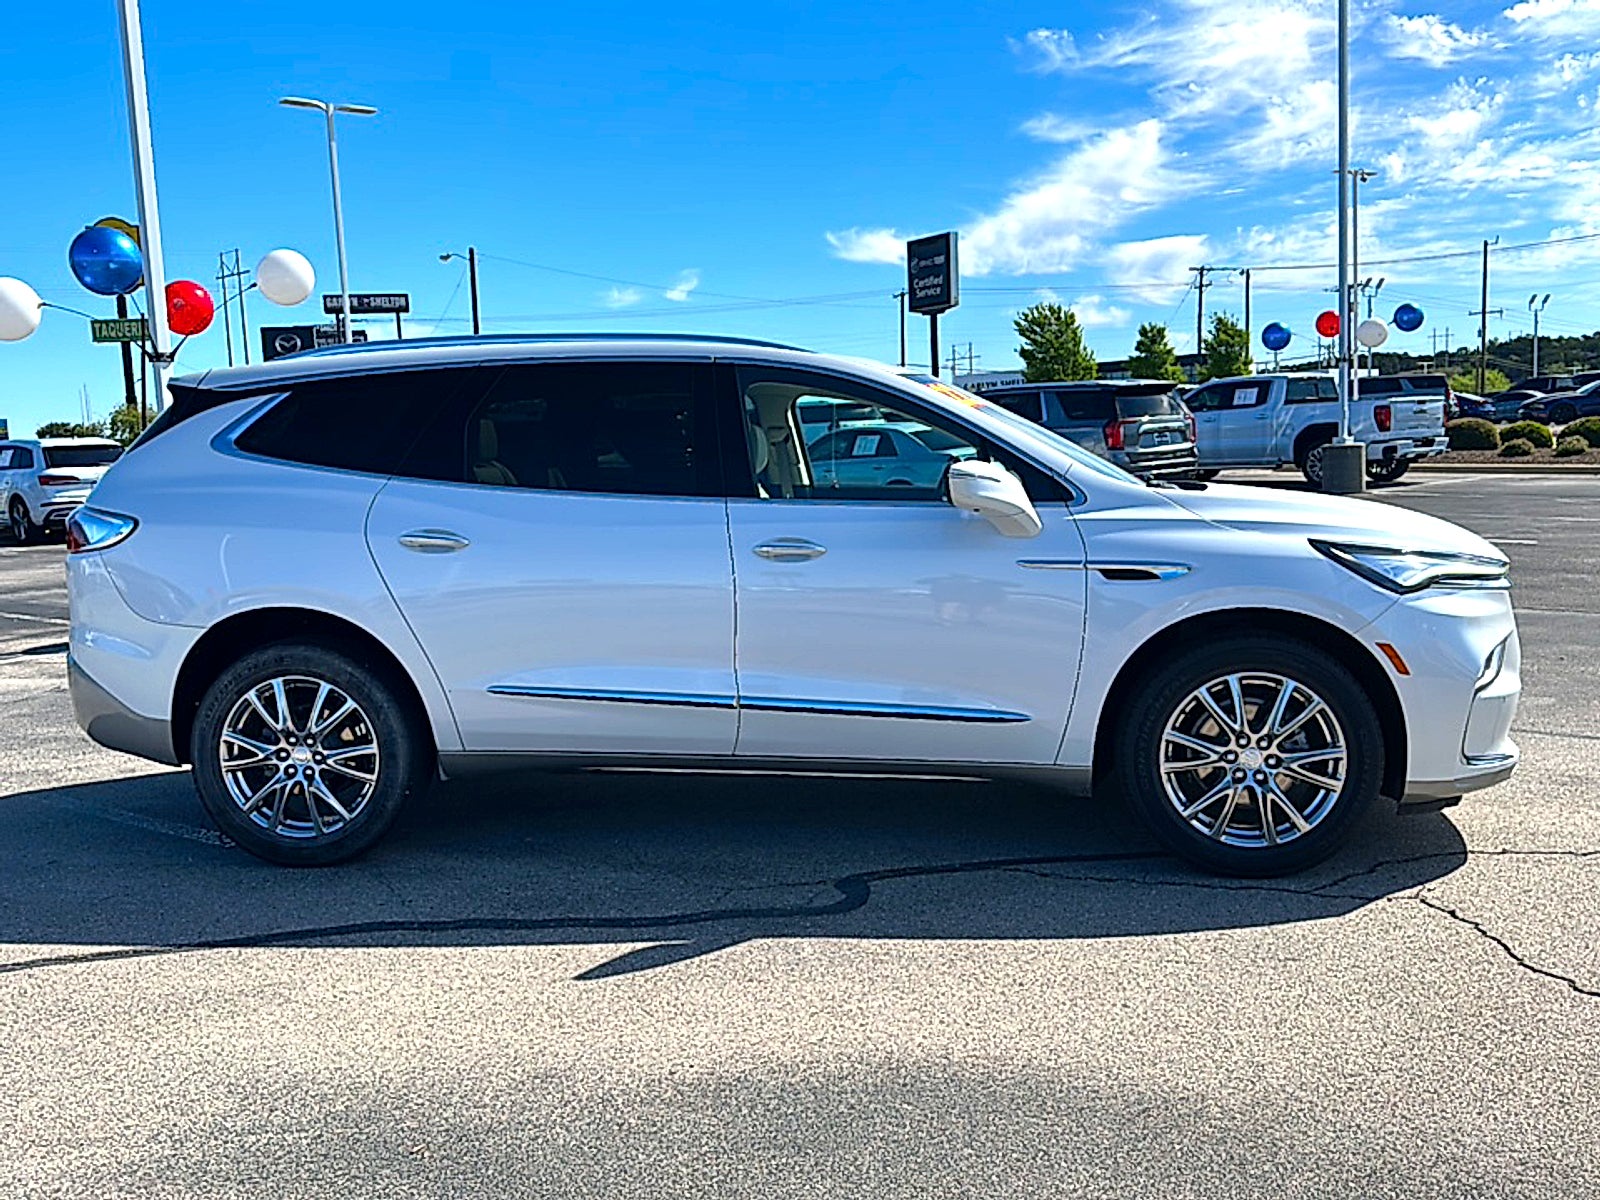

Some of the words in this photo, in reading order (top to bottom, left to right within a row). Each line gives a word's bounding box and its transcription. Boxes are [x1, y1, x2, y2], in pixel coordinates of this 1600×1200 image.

[914, 274, 943, 289] Certified
[916, 287, 941, 298] Service
[370, 296, 406, 308] SHELTON
